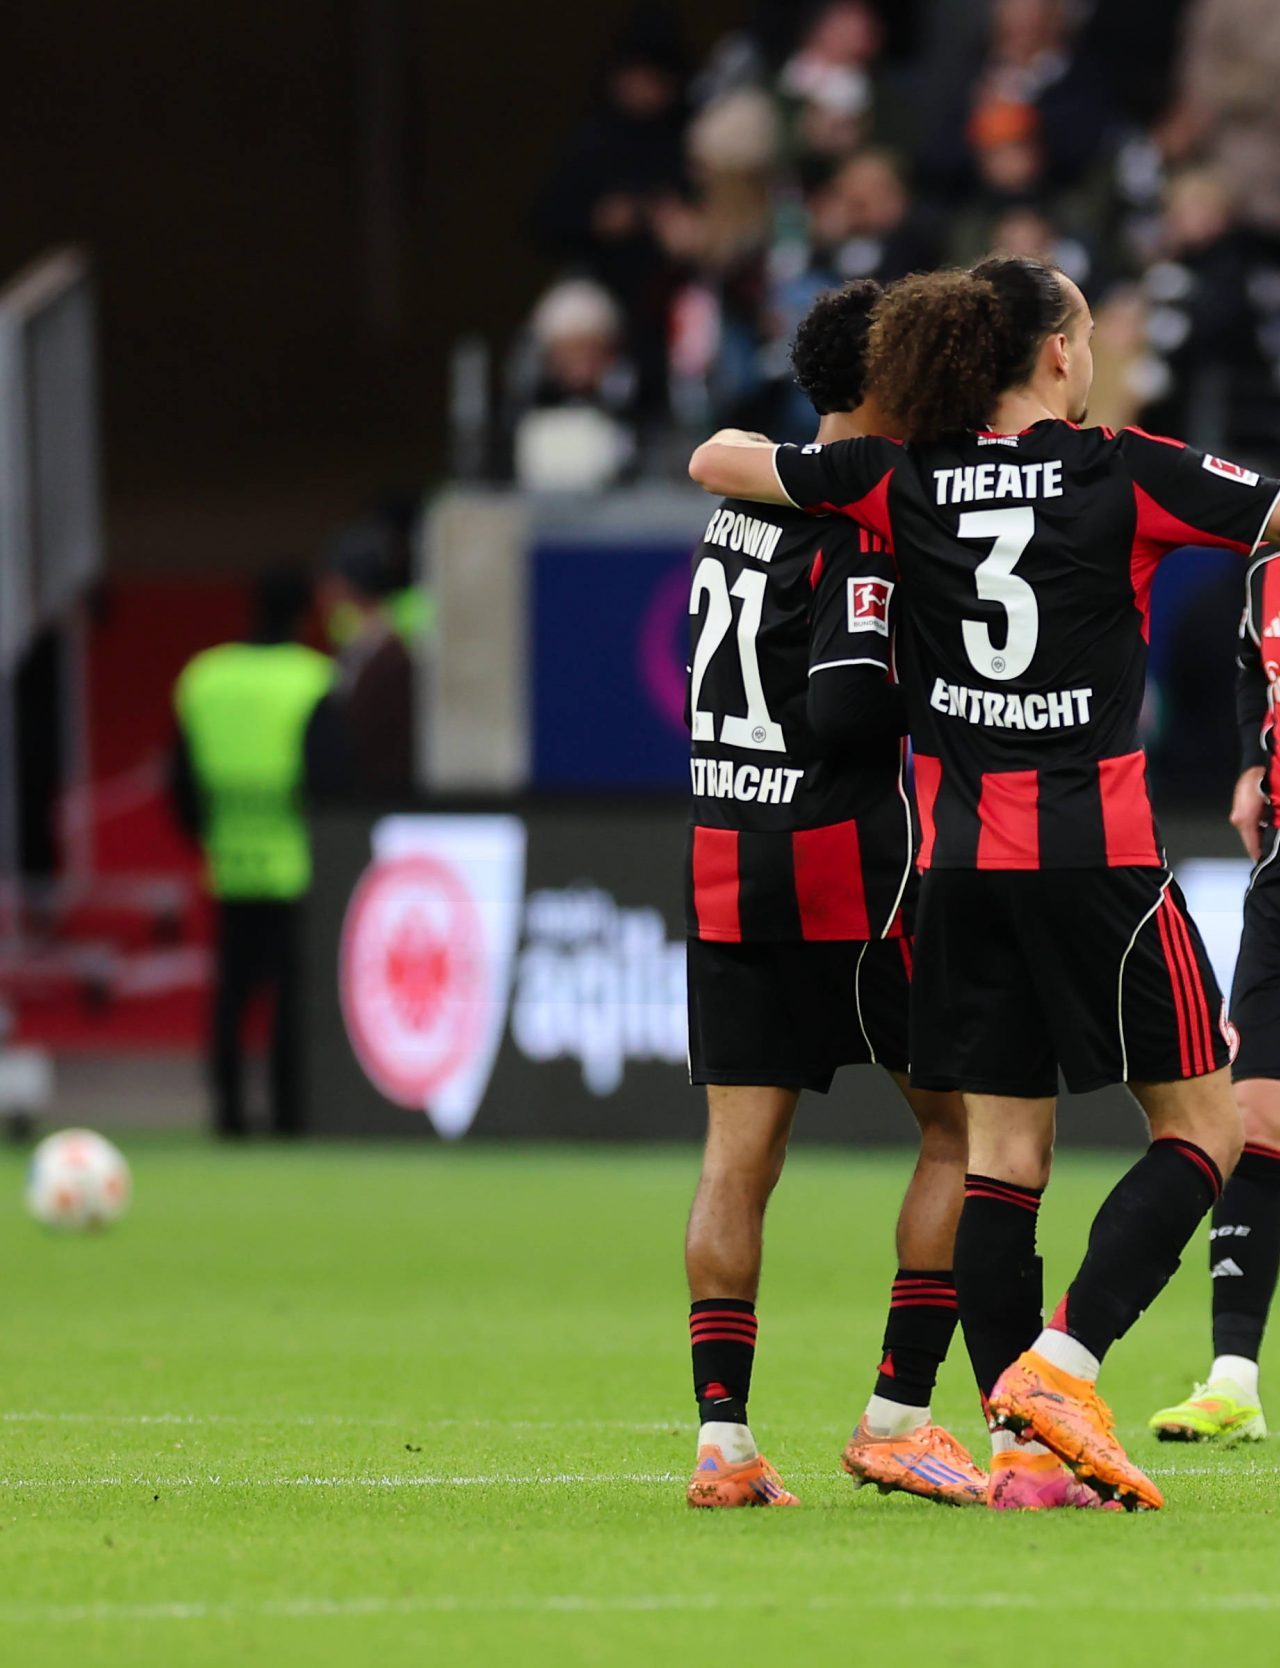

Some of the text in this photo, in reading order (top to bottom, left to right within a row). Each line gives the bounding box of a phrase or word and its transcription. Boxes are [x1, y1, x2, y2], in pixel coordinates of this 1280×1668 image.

[933, 460, 1063, 505] THEATE
[703, 508, 783, 563] BROWN
[957, 506, 1039, 680] 3
[689, 557, 787, 753] 21
[930, 677, 1093, 730] ENTRACHT
